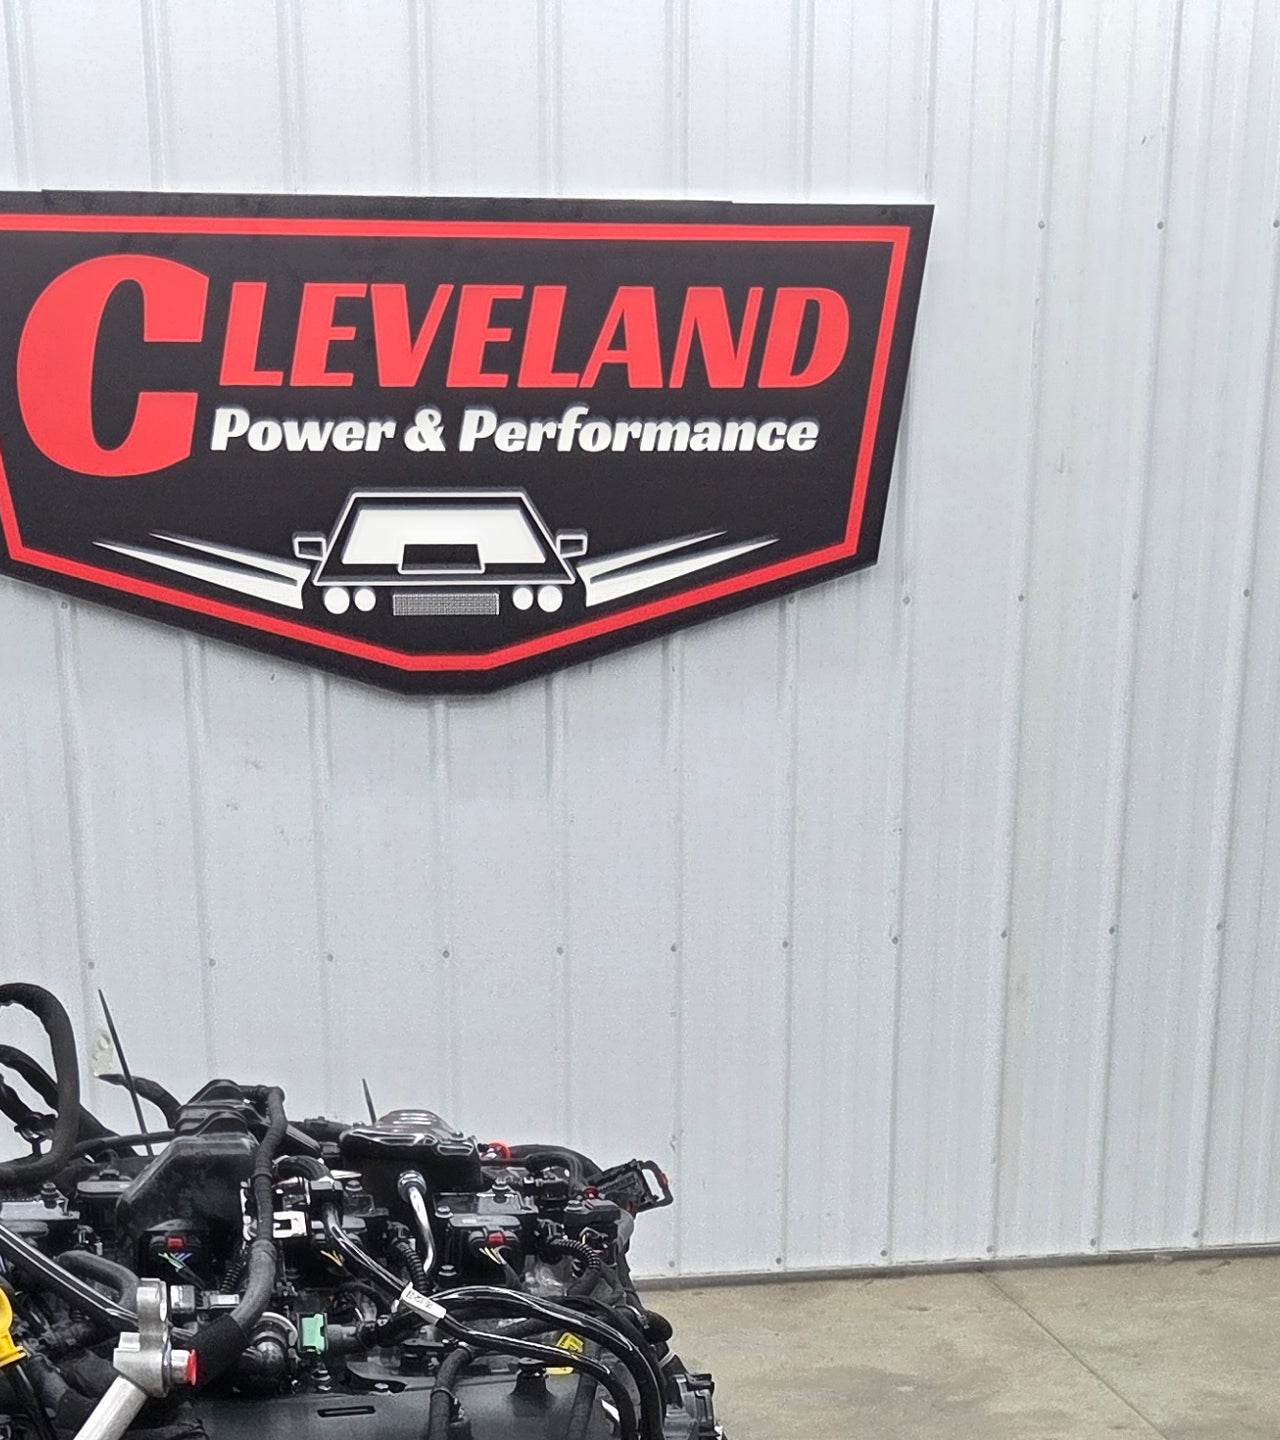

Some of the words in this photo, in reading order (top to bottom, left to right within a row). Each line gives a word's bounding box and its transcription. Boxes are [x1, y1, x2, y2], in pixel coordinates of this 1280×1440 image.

[17, 254, 850, 477] CLEVELAND
[210, 405, 396, 452] Power
[403, 406, 447, 453] &
[458, 402, 820, 453] Performance
